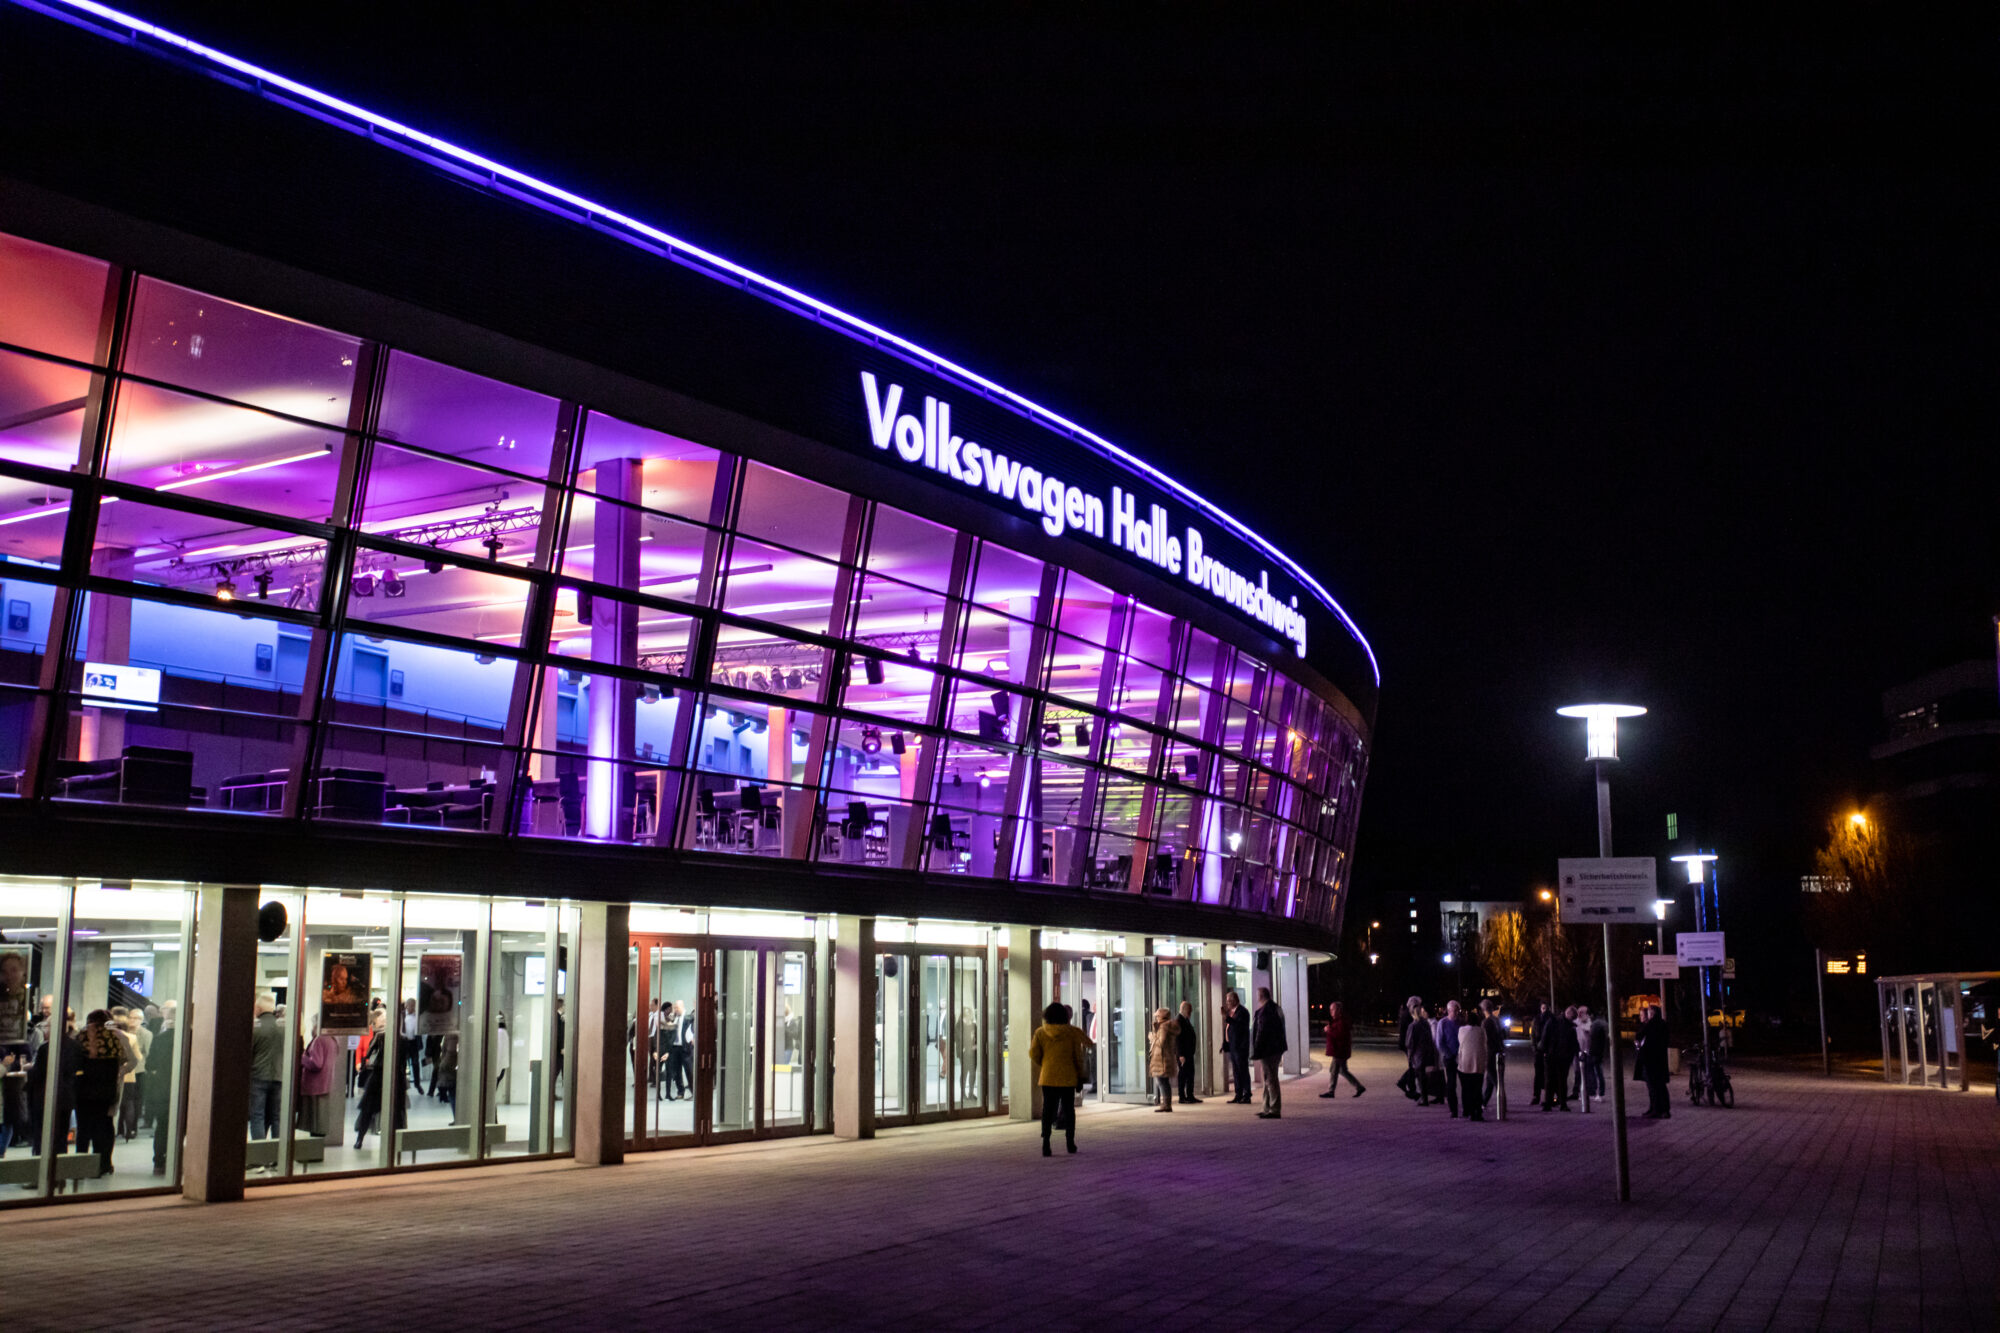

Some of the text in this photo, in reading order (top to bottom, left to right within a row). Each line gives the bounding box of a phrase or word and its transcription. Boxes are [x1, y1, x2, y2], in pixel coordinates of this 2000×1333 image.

[861, 371, 1307, 658] Volkswagen Halle Braunschweig
